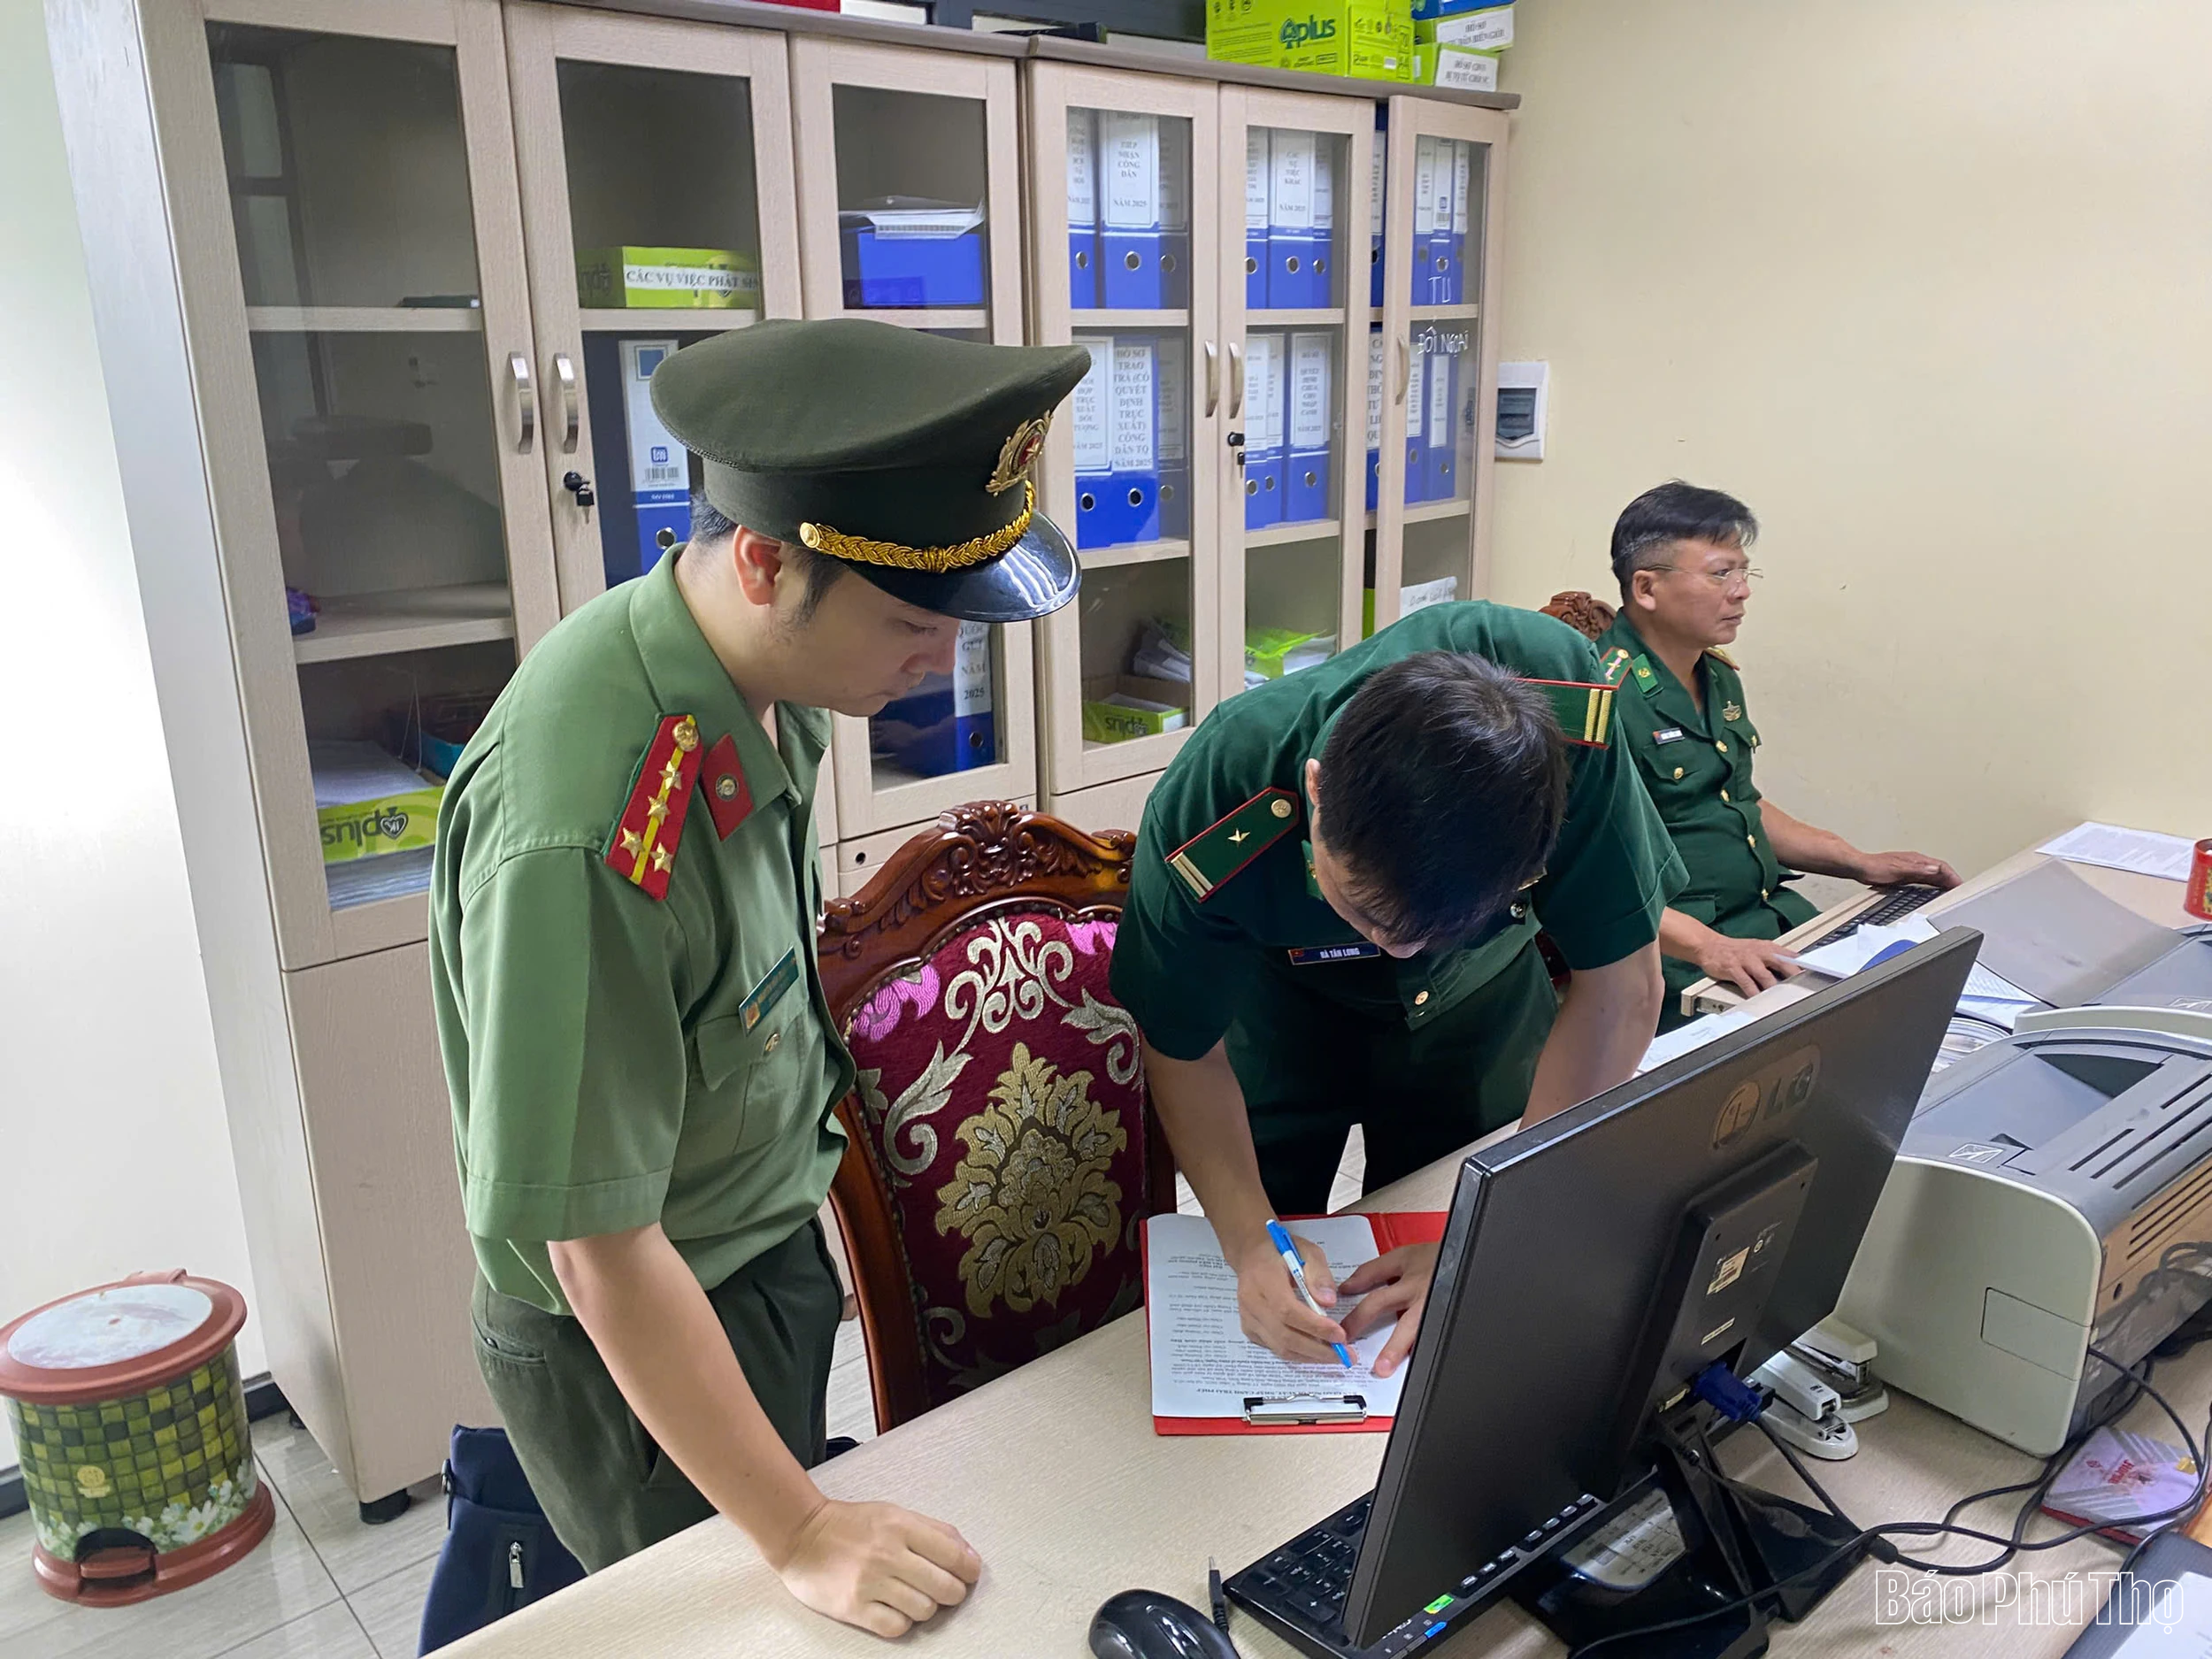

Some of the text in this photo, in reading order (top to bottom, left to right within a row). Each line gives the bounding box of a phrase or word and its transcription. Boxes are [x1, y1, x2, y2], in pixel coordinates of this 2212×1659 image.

[626, 268, 654, 283] CÁC
[656, 272, 676, 287] VỤ
[678, 271, 705, 288] VIỆC
[1118, 361, 1145, 370] TRAO
[1114, 384, 1148, 396] QUYẾT
[1118, 397, 1144, 408] ĐỊNH
[1118, 410, 1144, 424] TRỤC
[1118, 430, 1146, 442] CÔNG
[964, 687, 986, 701] 2025
